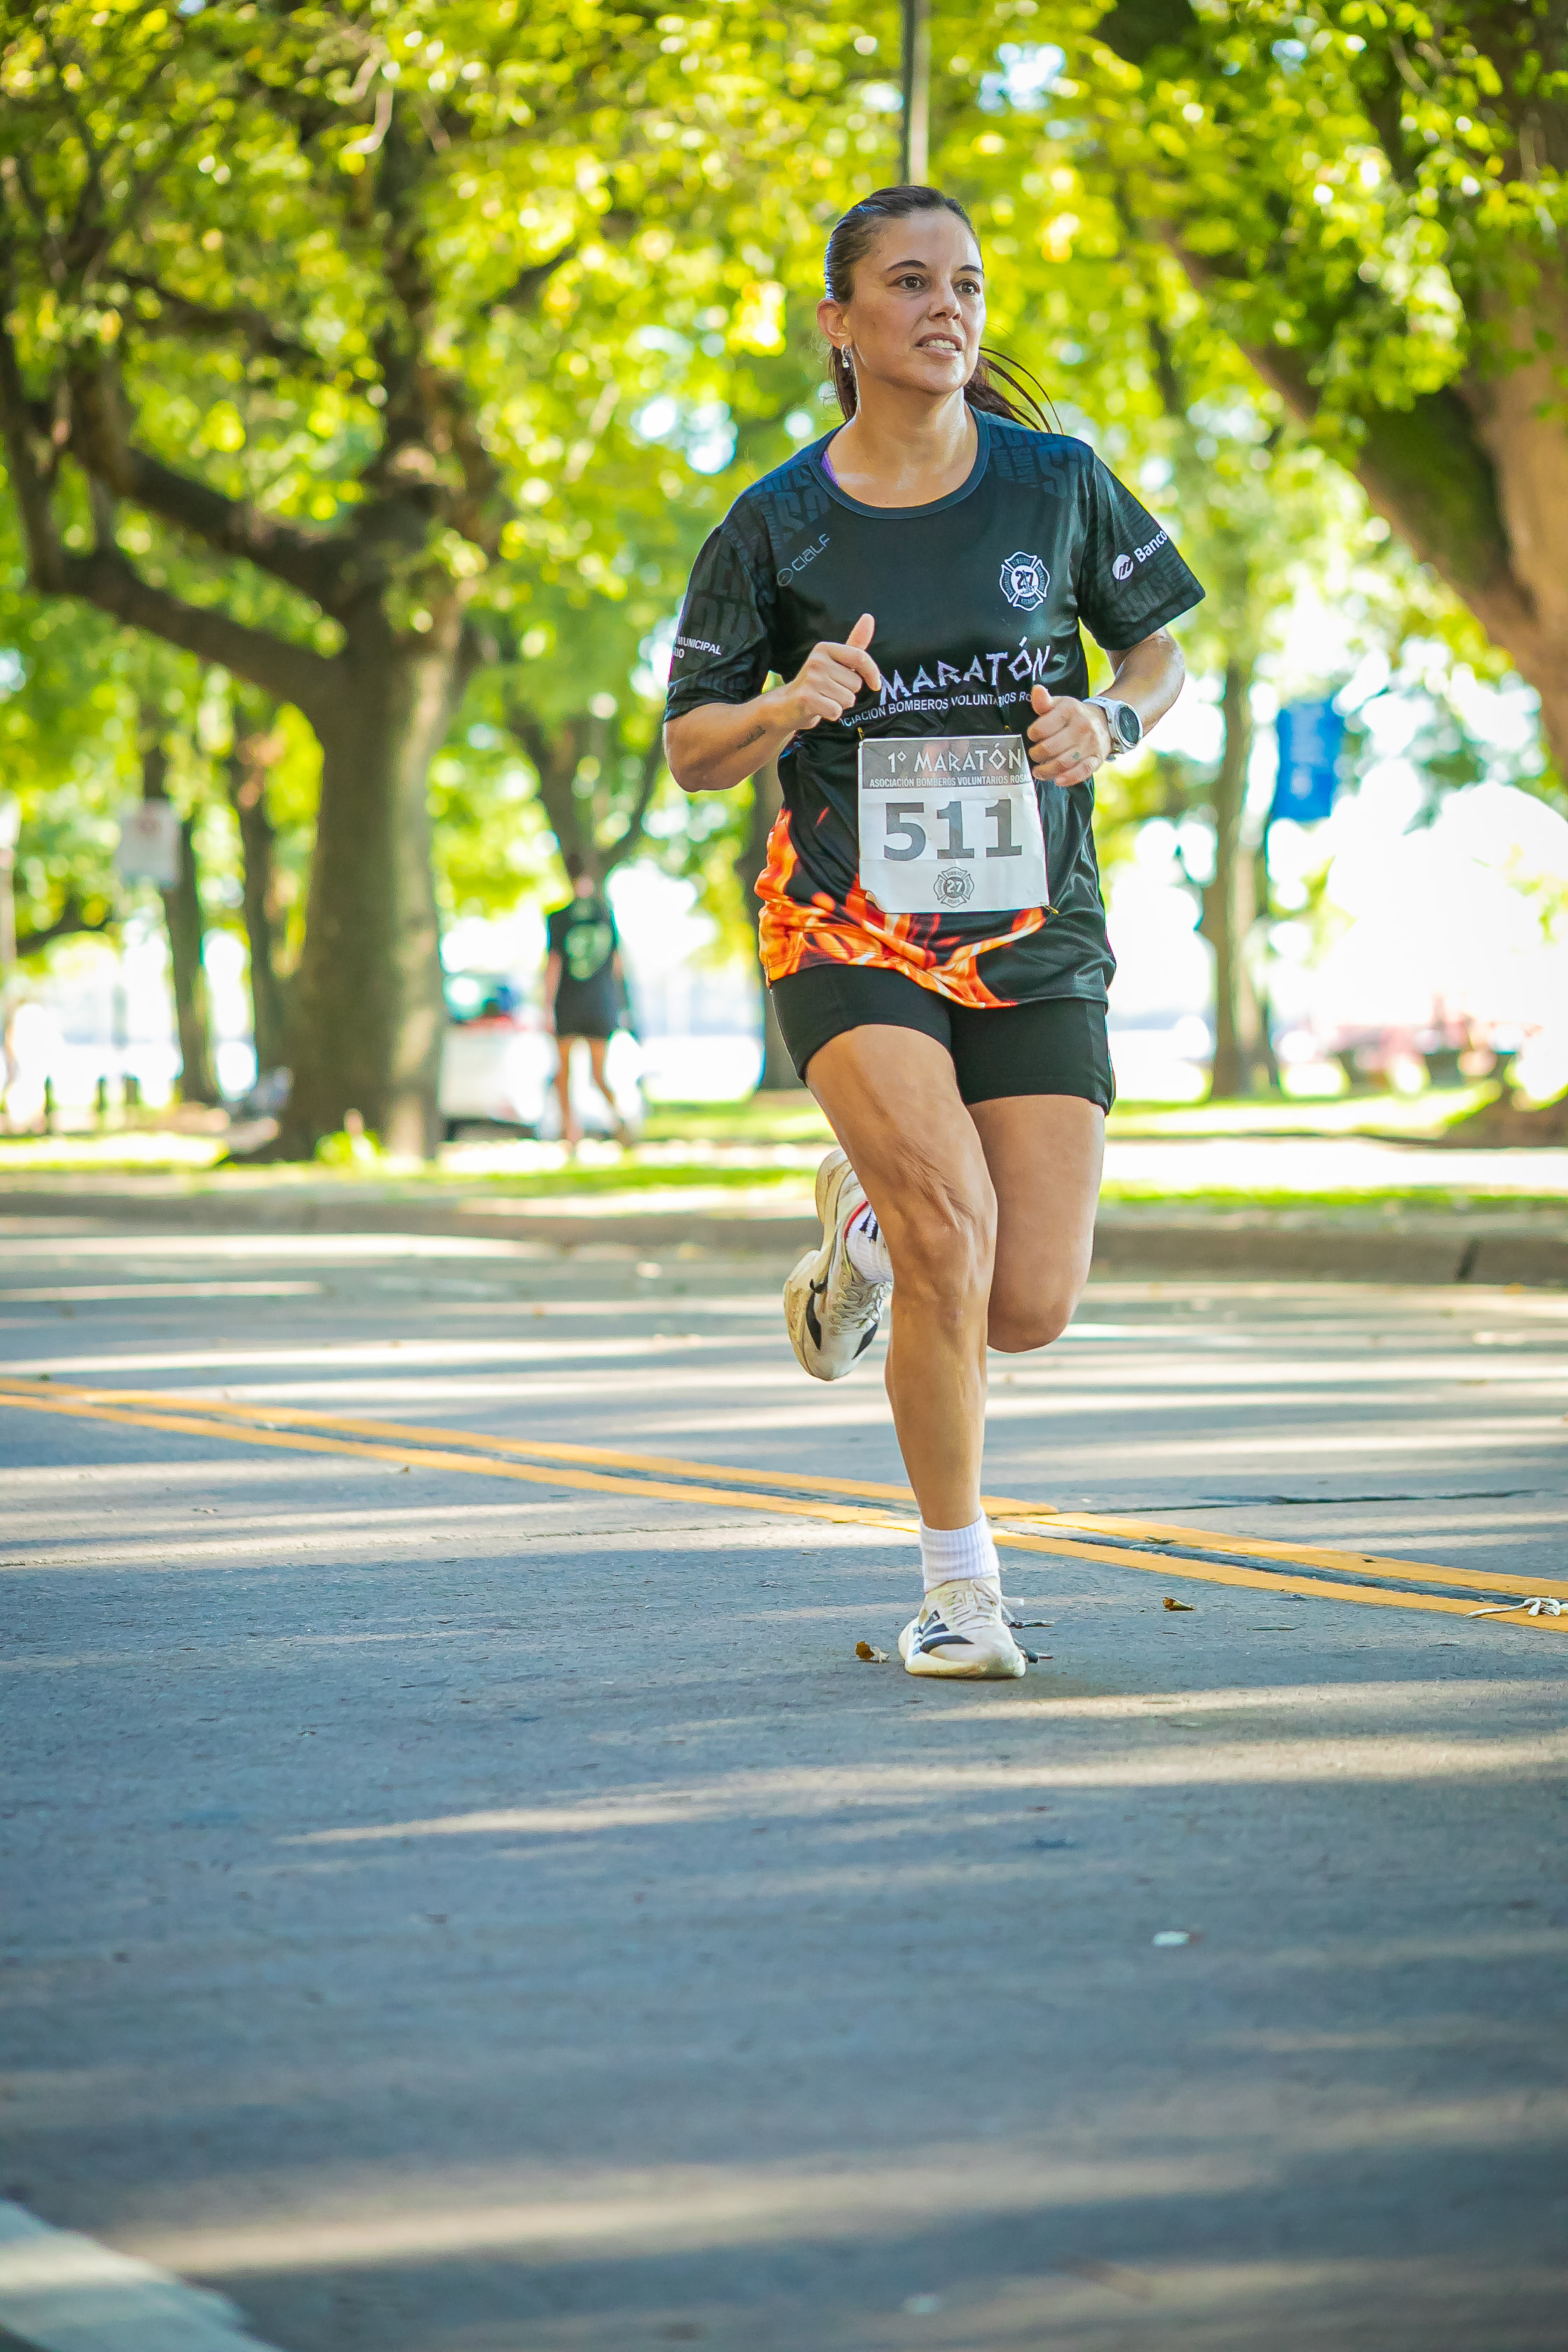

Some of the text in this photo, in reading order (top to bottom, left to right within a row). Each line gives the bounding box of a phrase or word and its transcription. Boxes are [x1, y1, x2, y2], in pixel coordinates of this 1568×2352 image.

[1133, 530, 1168, 563] Banco
[1015, 570, 1034, 590] 27
[677, 635, 722, 656] MUNICIPAL
[879, 636, 1050, 706] MARATÓN
[888, 698, 948, 714] BOMBEROS
[951, 692, 1016, 709] VOLUNTARIOS
[913, 742, 1021, 773] MARATÓN
[869, 776, 914, 788] ASOCIACIÓN
[915, 777, 955, 787] BOMBEROS
[957, 775, 1008, 785] VOLUNTARIOS
[884, 799, 1022, 861] 511
[947, 879, 963, 893] 27
